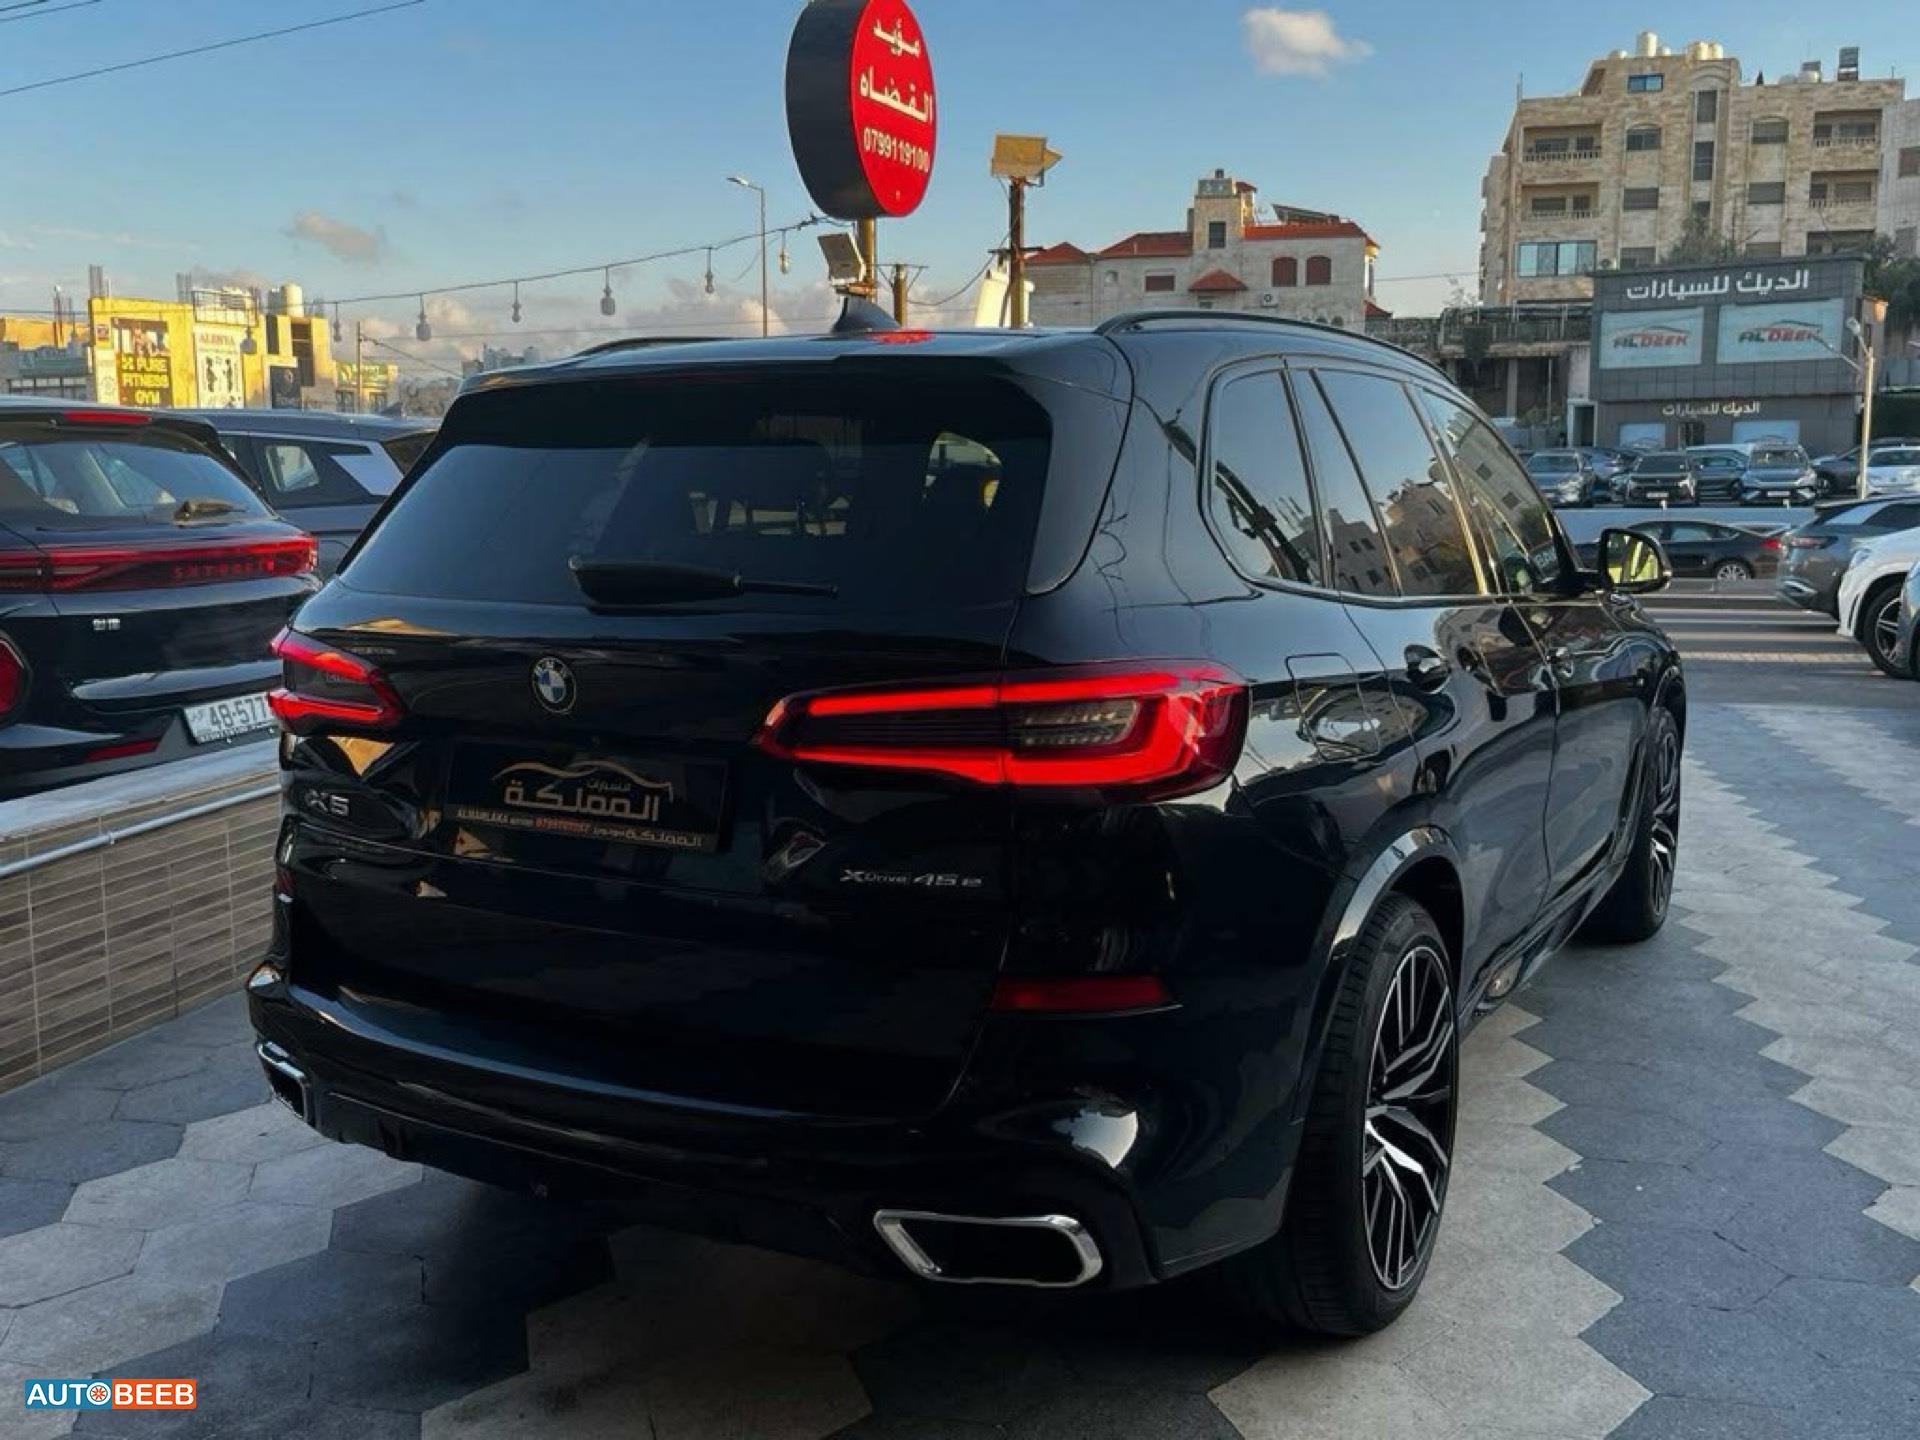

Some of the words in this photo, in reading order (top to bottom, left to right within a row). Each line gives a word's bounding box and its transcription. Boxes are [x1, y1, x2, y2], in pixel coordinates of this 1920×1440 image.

[1627, 275, 1729, 300] للسيارات
[1735, 269, 1809, 295] الديك
[1662, 402, 1719, 418] للسيارات
[304, 789, 350, 817] X5
[504, 779, 660, 822] المملكة
